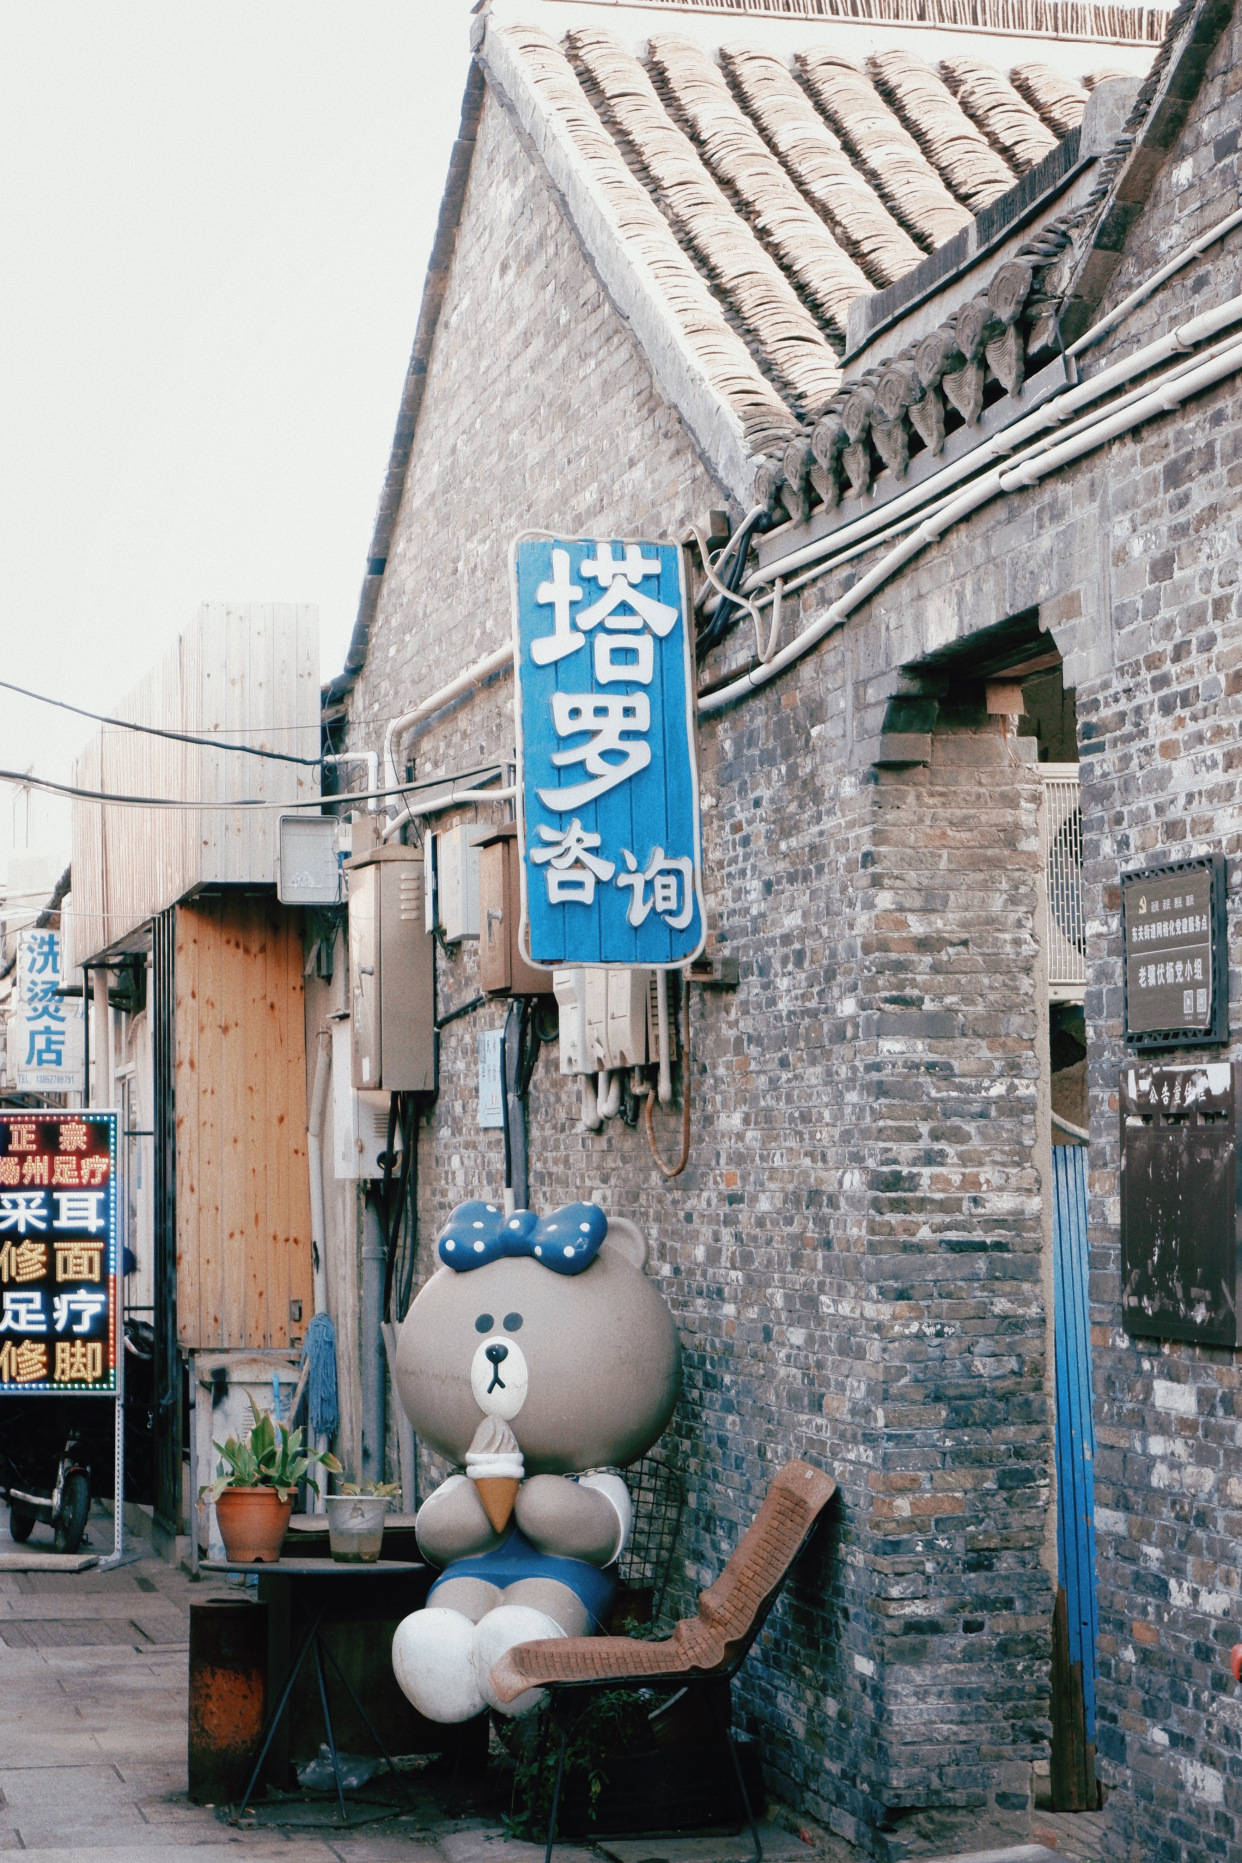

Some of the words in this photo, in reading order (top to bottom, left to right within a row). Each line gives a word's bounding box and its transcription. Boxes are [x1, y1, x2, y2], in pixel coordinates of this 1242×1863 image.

[530, 543, 680, 813] 塔罗
[530, 818, 693, 931] 咨询
[25, 933, 67, 1067] 洗烫店
[8, 1122, 87, 1151] 正宗
[0, 1191, 105, 1233] 采耳
[0, 1239, 104, 1283] 修面
[0, 1289, 106, 1333] 足疗
[0, 1339, 102, 1383] 修脚
